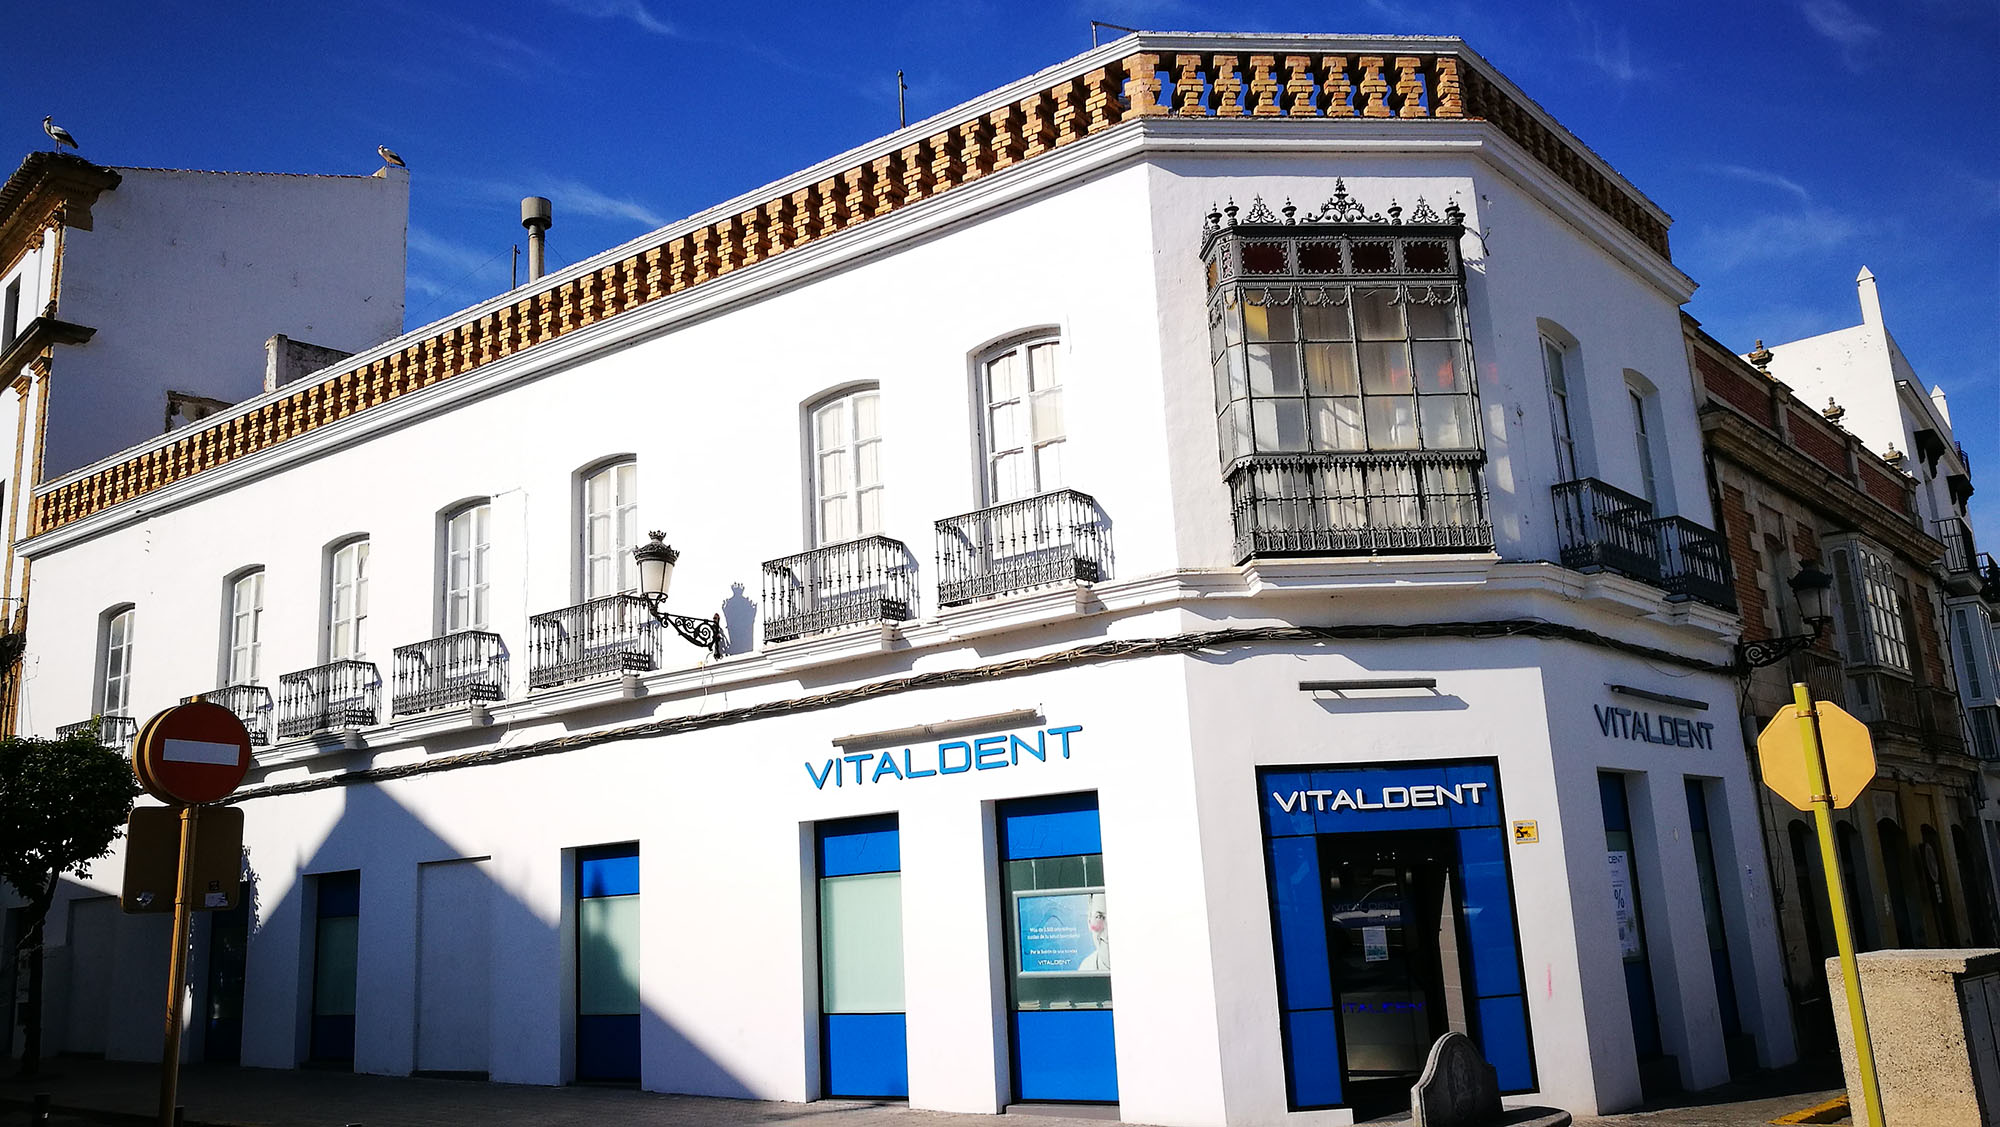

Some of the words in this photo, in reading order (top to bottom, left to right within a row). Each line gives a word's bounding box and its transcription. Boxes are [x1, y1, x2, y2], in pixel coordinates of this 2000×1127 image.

[1593, 704, 1714, 750] VITALDENT
[805, 725, 1083, 790] VITALDENT
[1273, 782, 1488, 813] VITALDENT
